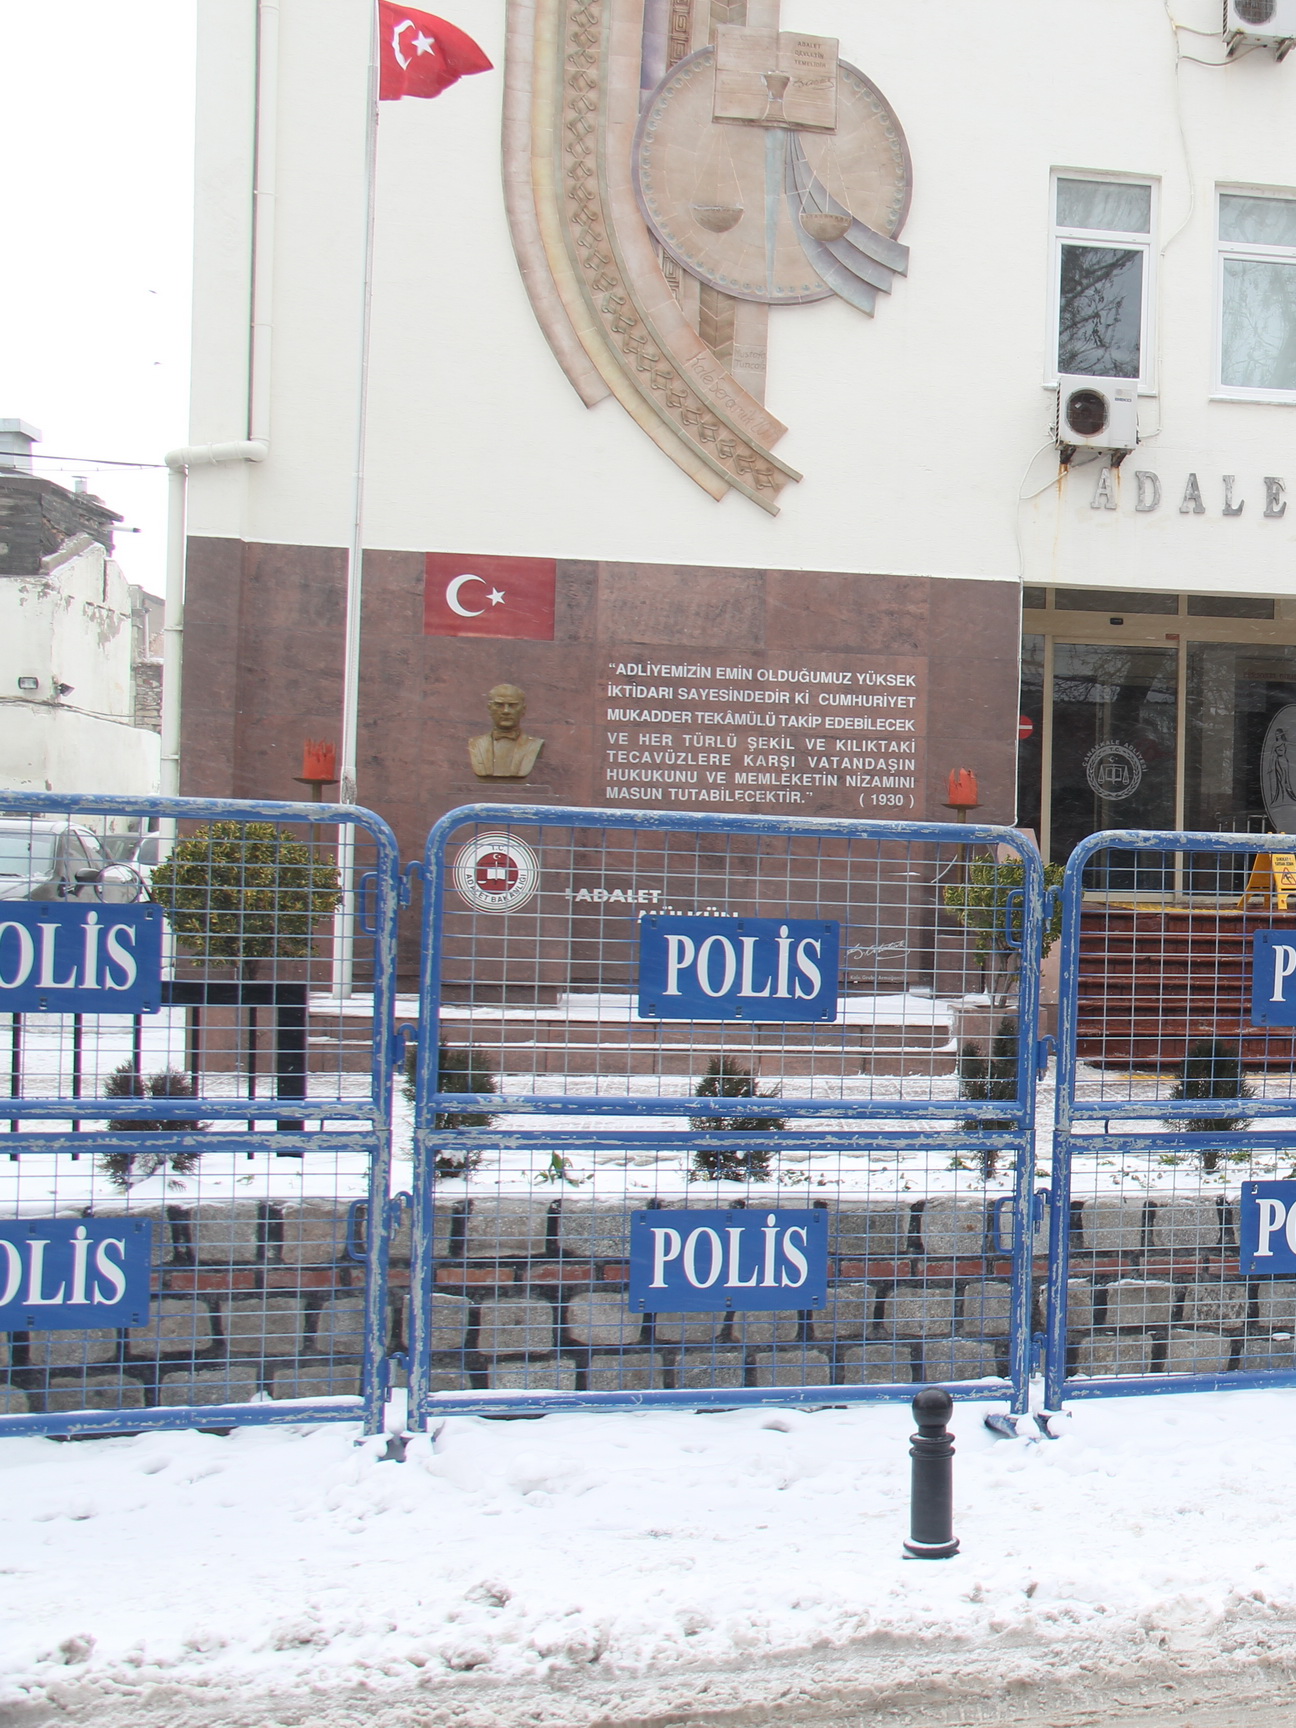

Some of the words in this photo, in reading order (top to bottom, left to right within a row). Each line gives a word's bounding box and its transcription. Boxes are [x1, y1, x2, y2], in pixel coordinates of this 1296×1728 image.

[716, 665, 752, 681] EMİN
[757, 667, 852, 685] OLDUĞUMUZ
[856, 670, 916, 687] YÜKSEK
[607, 682, 674, 699] İKTİDARI
[678, 686, 790, 704] SAYESİNDEDİR
[794, 689, 809, 704] Kİ
[818, 692, 916, 708] CUMHURİYET
[607, 708, 692, 723] MUKADDER
[695, 710, 776, 727] TEKÂMÜLÜ
[778, 712, 822, 728] TAKİP
[825, 715, 915, 731] EDEBİLECEK
[607, 732, 629, 745] VE
[639, 733, 672, 746] HER
[682, 732, 737, 748] TÜRLÜ
[747, 734, 795, 752] ŞEKİL
[805, 738, 826, 751] VE
[836, 738, 915, 753] KILIKTAKİ
[606, 749, 731, 766] TECAVÜZLERE
[743, 754, 795, 770] KARŞI
[807, 756, 915, 773] VATANDAŞIN
[606, 768, 697, 782] HUKUKUNU
[706, 771, 727, 784] VE
[734, 771, 838, 786] MEMLEKETİN
[846, 772, 915, 788] NİZAMINI
[606, 786, 662, 800] MASUN
[663, 925, 822, 1000] POLİS
[649, 1214, 808, 1289] POLİS
